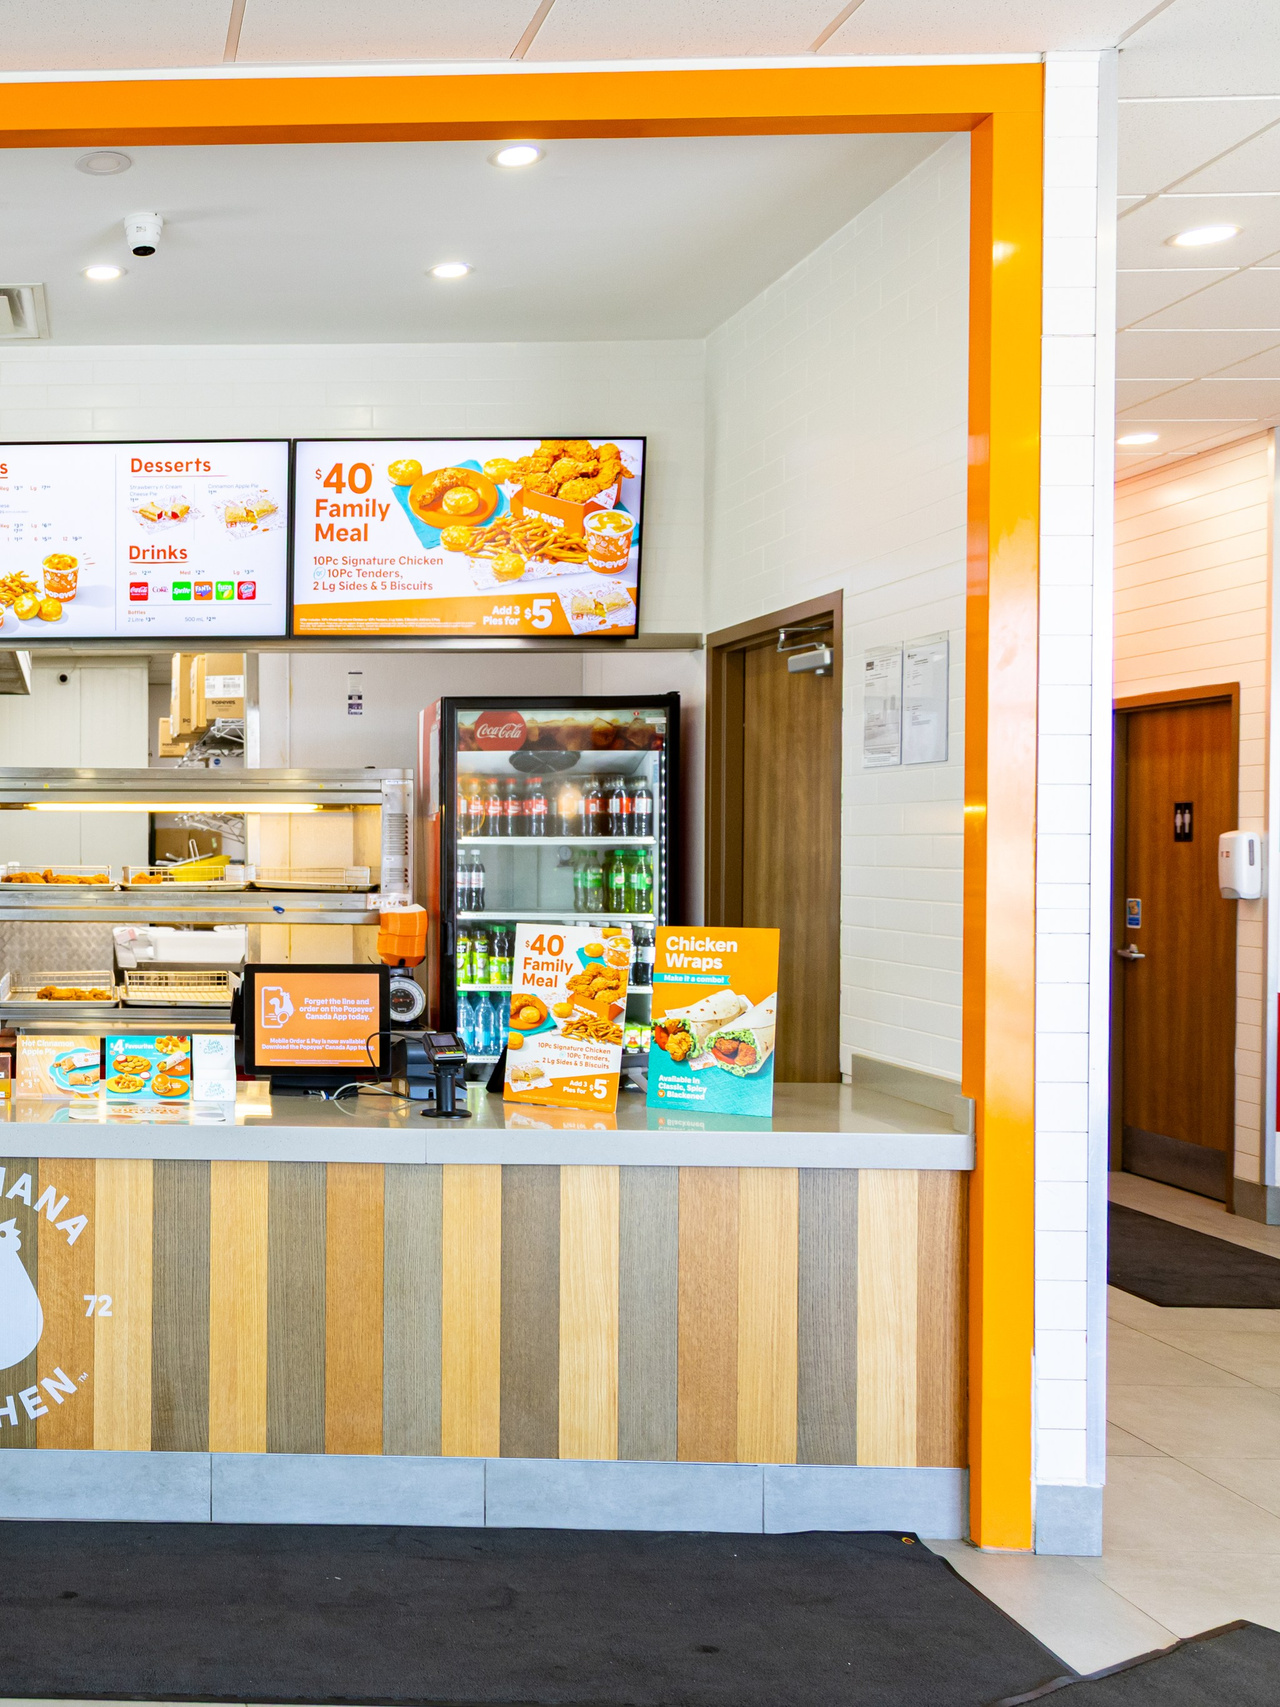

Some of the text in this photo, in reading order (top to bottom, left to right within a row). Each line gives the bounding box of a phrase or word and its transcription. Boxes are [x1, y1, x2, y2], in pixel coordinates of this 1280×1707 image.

[131, 458, 211, 472] Desserts
[314, 499, 391, 521] Family
[314, 524, 369, 542] Meal
[129, 545, 188, 560] Drinks
[313, 555, 444, 568] 10Pc Signature Chicken
[327, 569, 353, 579] 10Pc
[355, 568, 404, 580] Tenders,
[312, 581, 433, 592] 2 Lg Sides & 5 Biscuits
[492, 606, 520, 615] Add 3
[482, 616, 503, 626] Pies
[505, 615, 520, 625] for
[476, 723, 524, 739] Coca-Cola
[666, 936, 738, 953] Chicken
[523, 958, 573, 976] Family
[666, 953, 723, 970] Wraps
[522, 974, 558, 988] Meal
[696, 975, 724, 984] combo!
[659, 1075, 691, 1083] Available
[658, 1083, 707, 1093] Classic, Spicy
[667, 1090, 705, 1100] Blackened
[83, 1294, 113, 1317] 72
